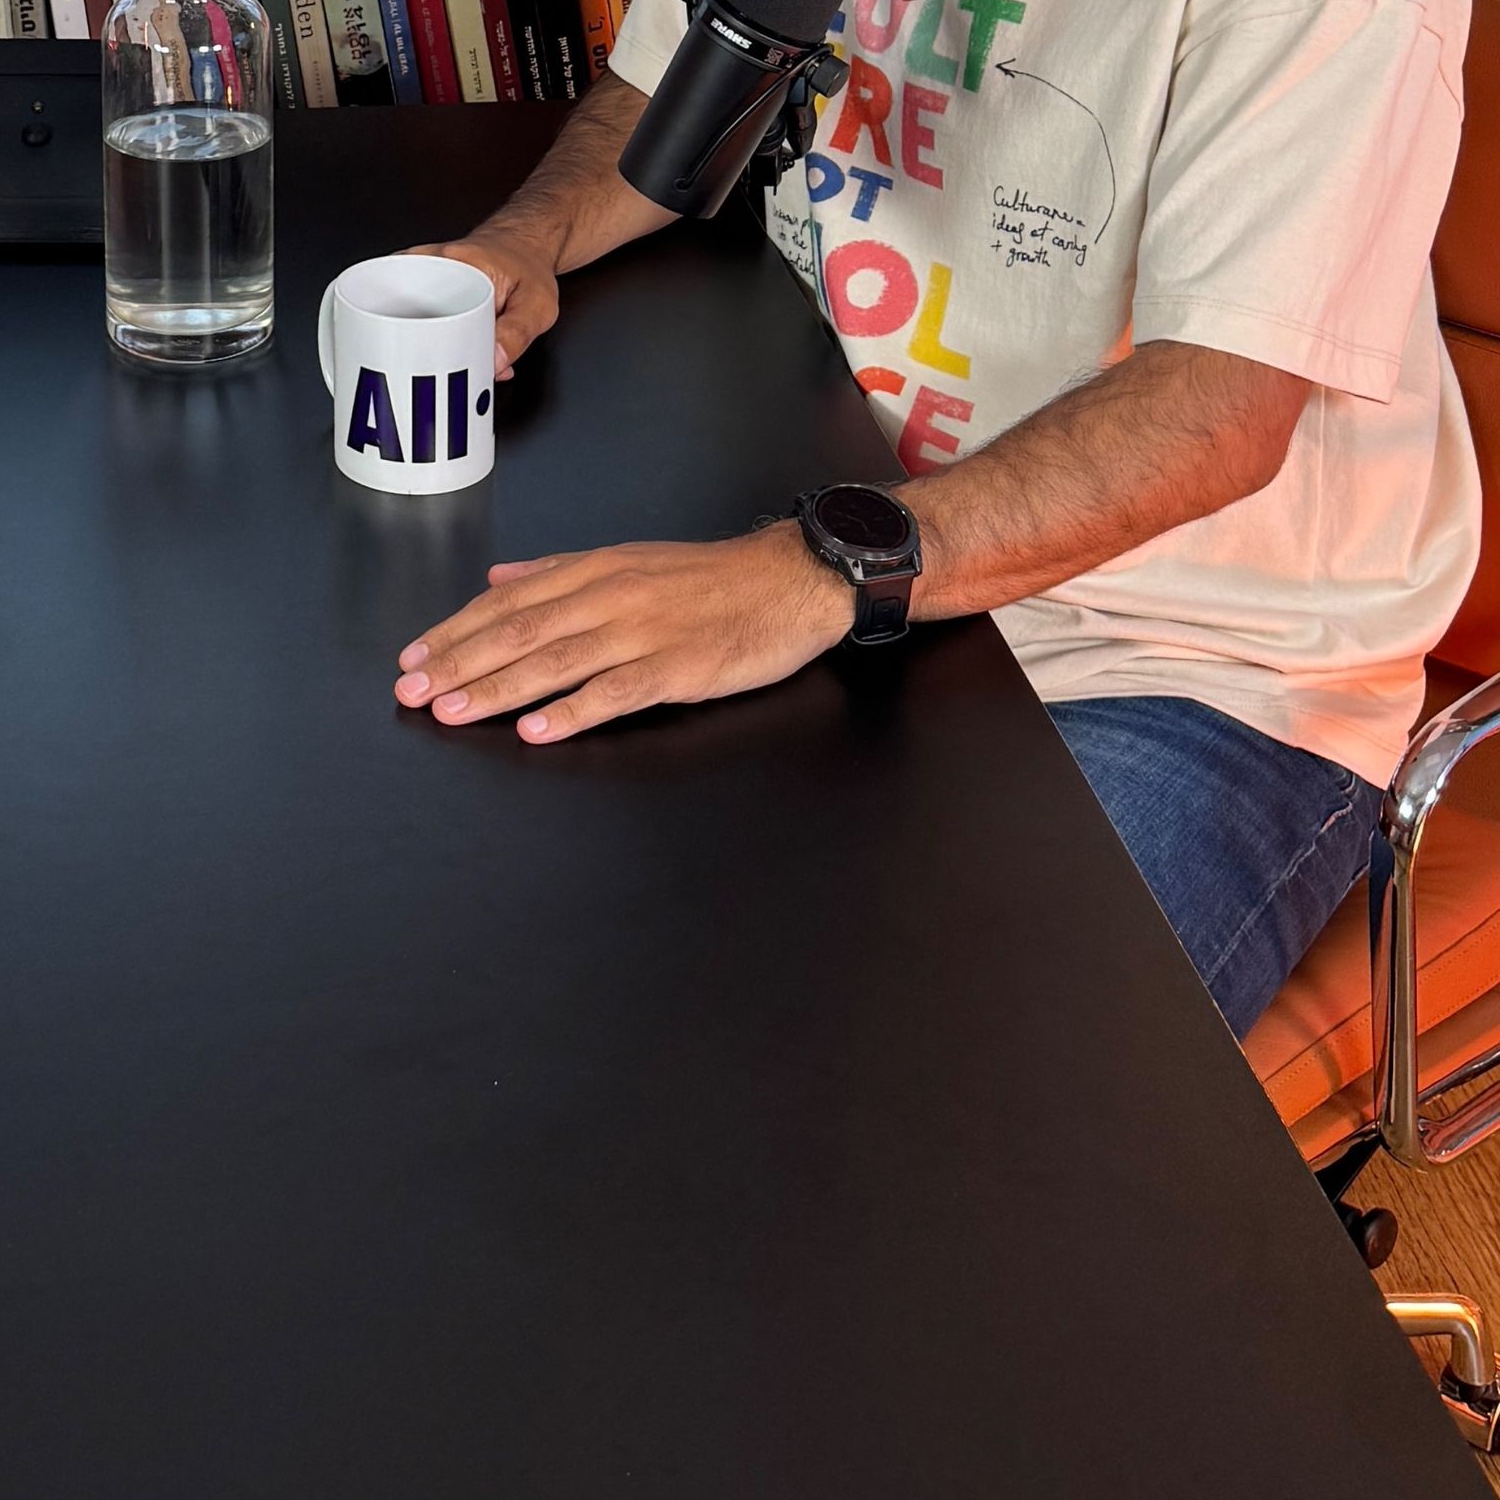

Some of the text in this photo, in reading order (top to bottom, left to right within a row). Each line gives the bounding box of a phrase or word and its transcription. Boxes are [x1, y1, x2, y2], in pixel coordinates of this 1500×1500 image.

[353, 5, 372, 59] 1914
[711, 18, 752, 49] SHURE
[815, 43, 951, 190] RE
[805, 151, 893, 222] OT
[803, 218, 971, 380] OL
